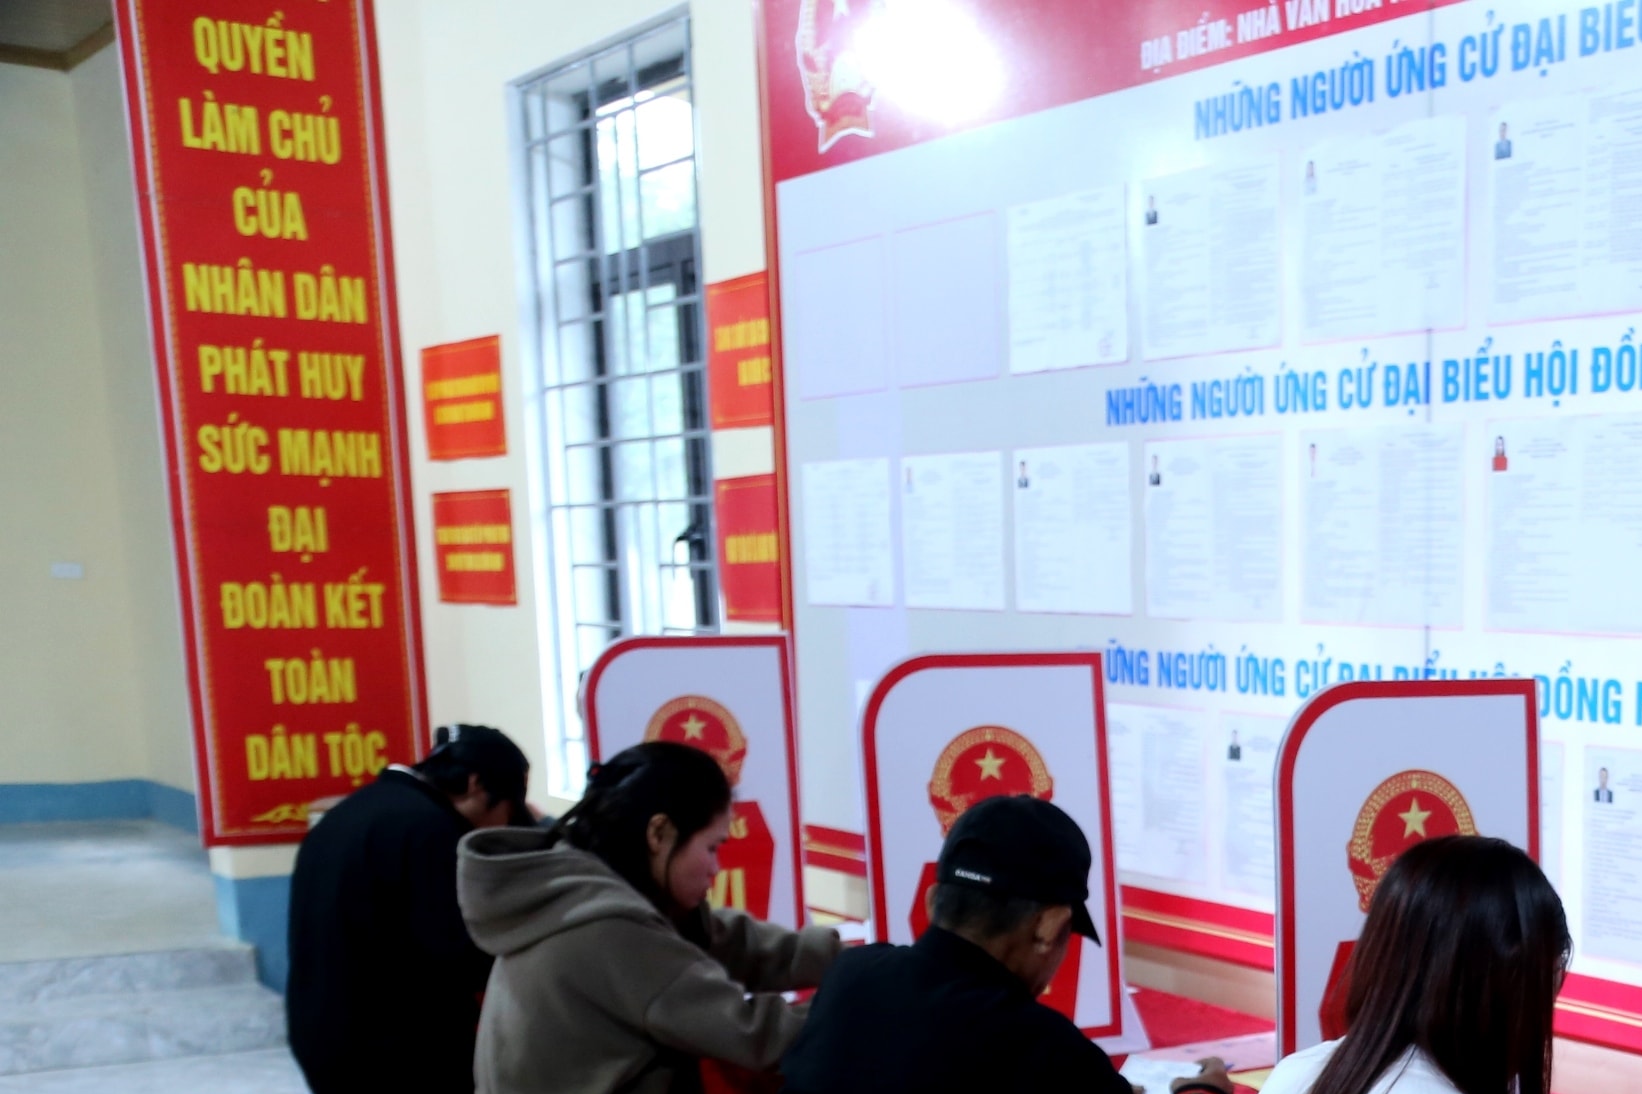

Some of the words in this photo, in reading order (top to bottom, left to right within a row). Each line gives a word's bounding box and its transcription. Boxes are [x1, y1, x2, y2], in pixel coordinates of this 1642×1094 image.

[192, 11, 315, 82] QUYỀN
[1140, 36, 1173, 73] ĐỊA
[1194, 79, 1281, 141] NHỮNG
[1290, 51, 1375, 120] NGƯỜI
[1385, 39, 1447, 98] ỨNG
[1458, 9, 1505, 82] CỬ
[1511, 13, 1567, 76] ĐẠI
[178, 90, 261, 156] LÀM
[268, 95, 341, 165] CHỦ
[232, 168, 308, 241] CỦA
[182, 257, 287, 319] NHÂN
[293, 264, 368, 324] DÂN
[198, 337, 289, 397] PHÁT
[298, 352, 365, 401] HUY
[1106, 377, 1182, 427] NHỮNG
[1190, 367, 1264, 420] NGƯỜI
[1274, 362, 1327, 414] ỨNG
[1338, 348, 1378, 410] CỬ
[1383, 361, 1432, 415] ĐẠI
[1443, 337, 1512, 404] BIỂU
[1524, 341, 1578, 406] HỘI
[197, 411, 270, 475] SỨC
[277, 428, 381, 487] MẠNH
[268, 506, 328, 562] ĐẠI
[221, 572, 318, 628] ĐOÀN
[323, 567, 385, 628] KẾT
[265, 648, 356, 704] TOÀN
[1105, 639, 1149, 686] ỮNG
[1157, 645, 1226, 693] NGƯỜI
[1236, 647, 1286, 697] ỨNG
[245, 725, 318, 780] DÂN
[323, 722, 388, 787] TỘC
